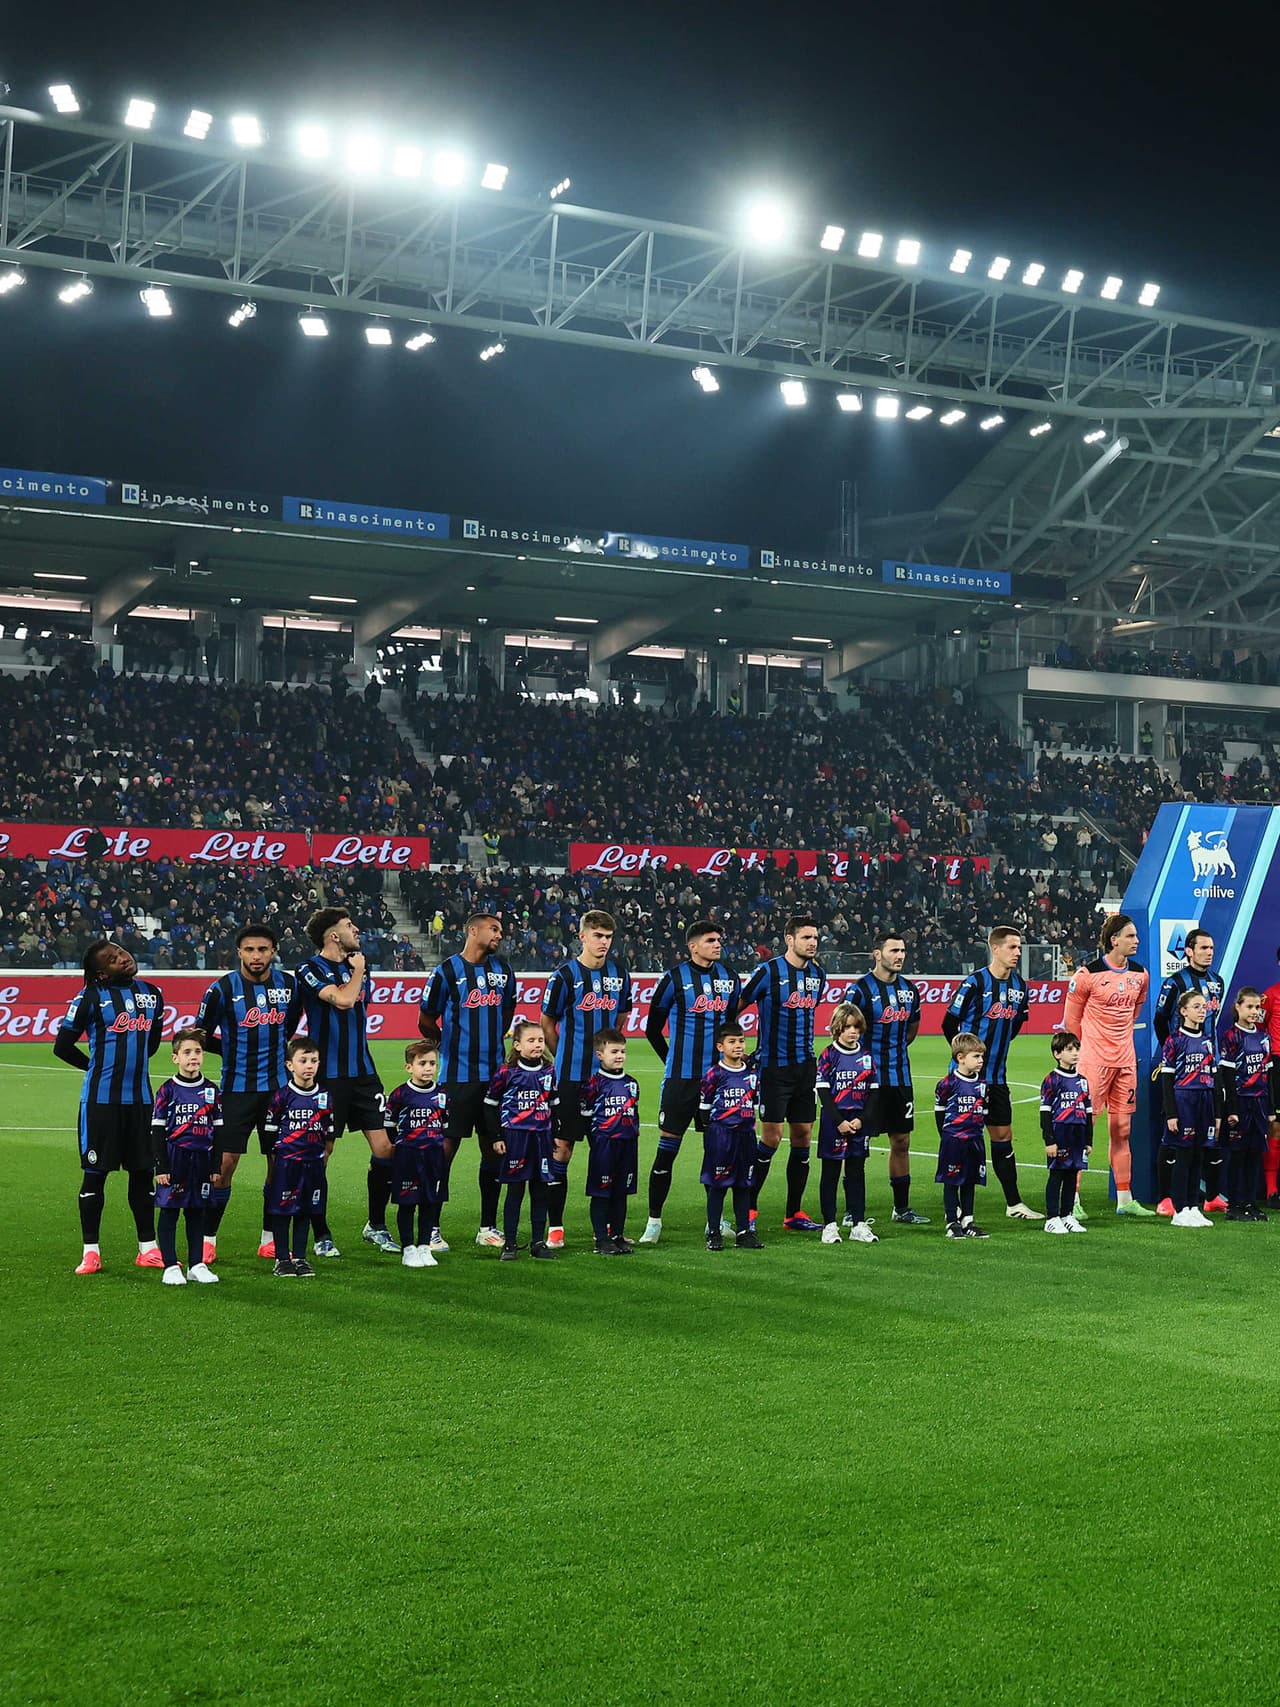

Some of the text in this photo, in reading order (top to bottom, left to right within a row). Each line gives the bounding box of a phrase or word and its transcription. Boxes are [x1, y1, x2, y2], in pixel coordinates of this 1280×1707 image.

[300, 504, 436, 531] Rinascimento
[761, 550, 873, 575] Rinascimento
[896, 567, 1000, 588] Rinascimento
[48, 827, 286, 861] Lte Lete
[320, 836, 412, 865] Lete
[1193, 885, 1235, 898] enilive
[577, 992, 616, 1011] Lete
[689, 995, 729, 1012] Lete
[107, 1012, 152, 1032] Lete
[240, 1007, 285, 1027] Lete
[1185, 1053, 1204, 1063] KEEP
[1246, 1053, 1264, 1063] KEEP
[836, 1071, 857, 1081] KEEP
[517, 1090, 540, 1100] KEEP
[723, 1088, 746, 1098] KEEP
[1060, 1092, 1078, 1100] KEEP
[604, 1096, 627, 1106] KEEP
[957, 1096, 978, 1105] KEEP
[175, 1104, 199, 1114] KEEP
[288, 1109, 314, 1119] KEEP
[410, 1108, 431, 1117] KEEP
